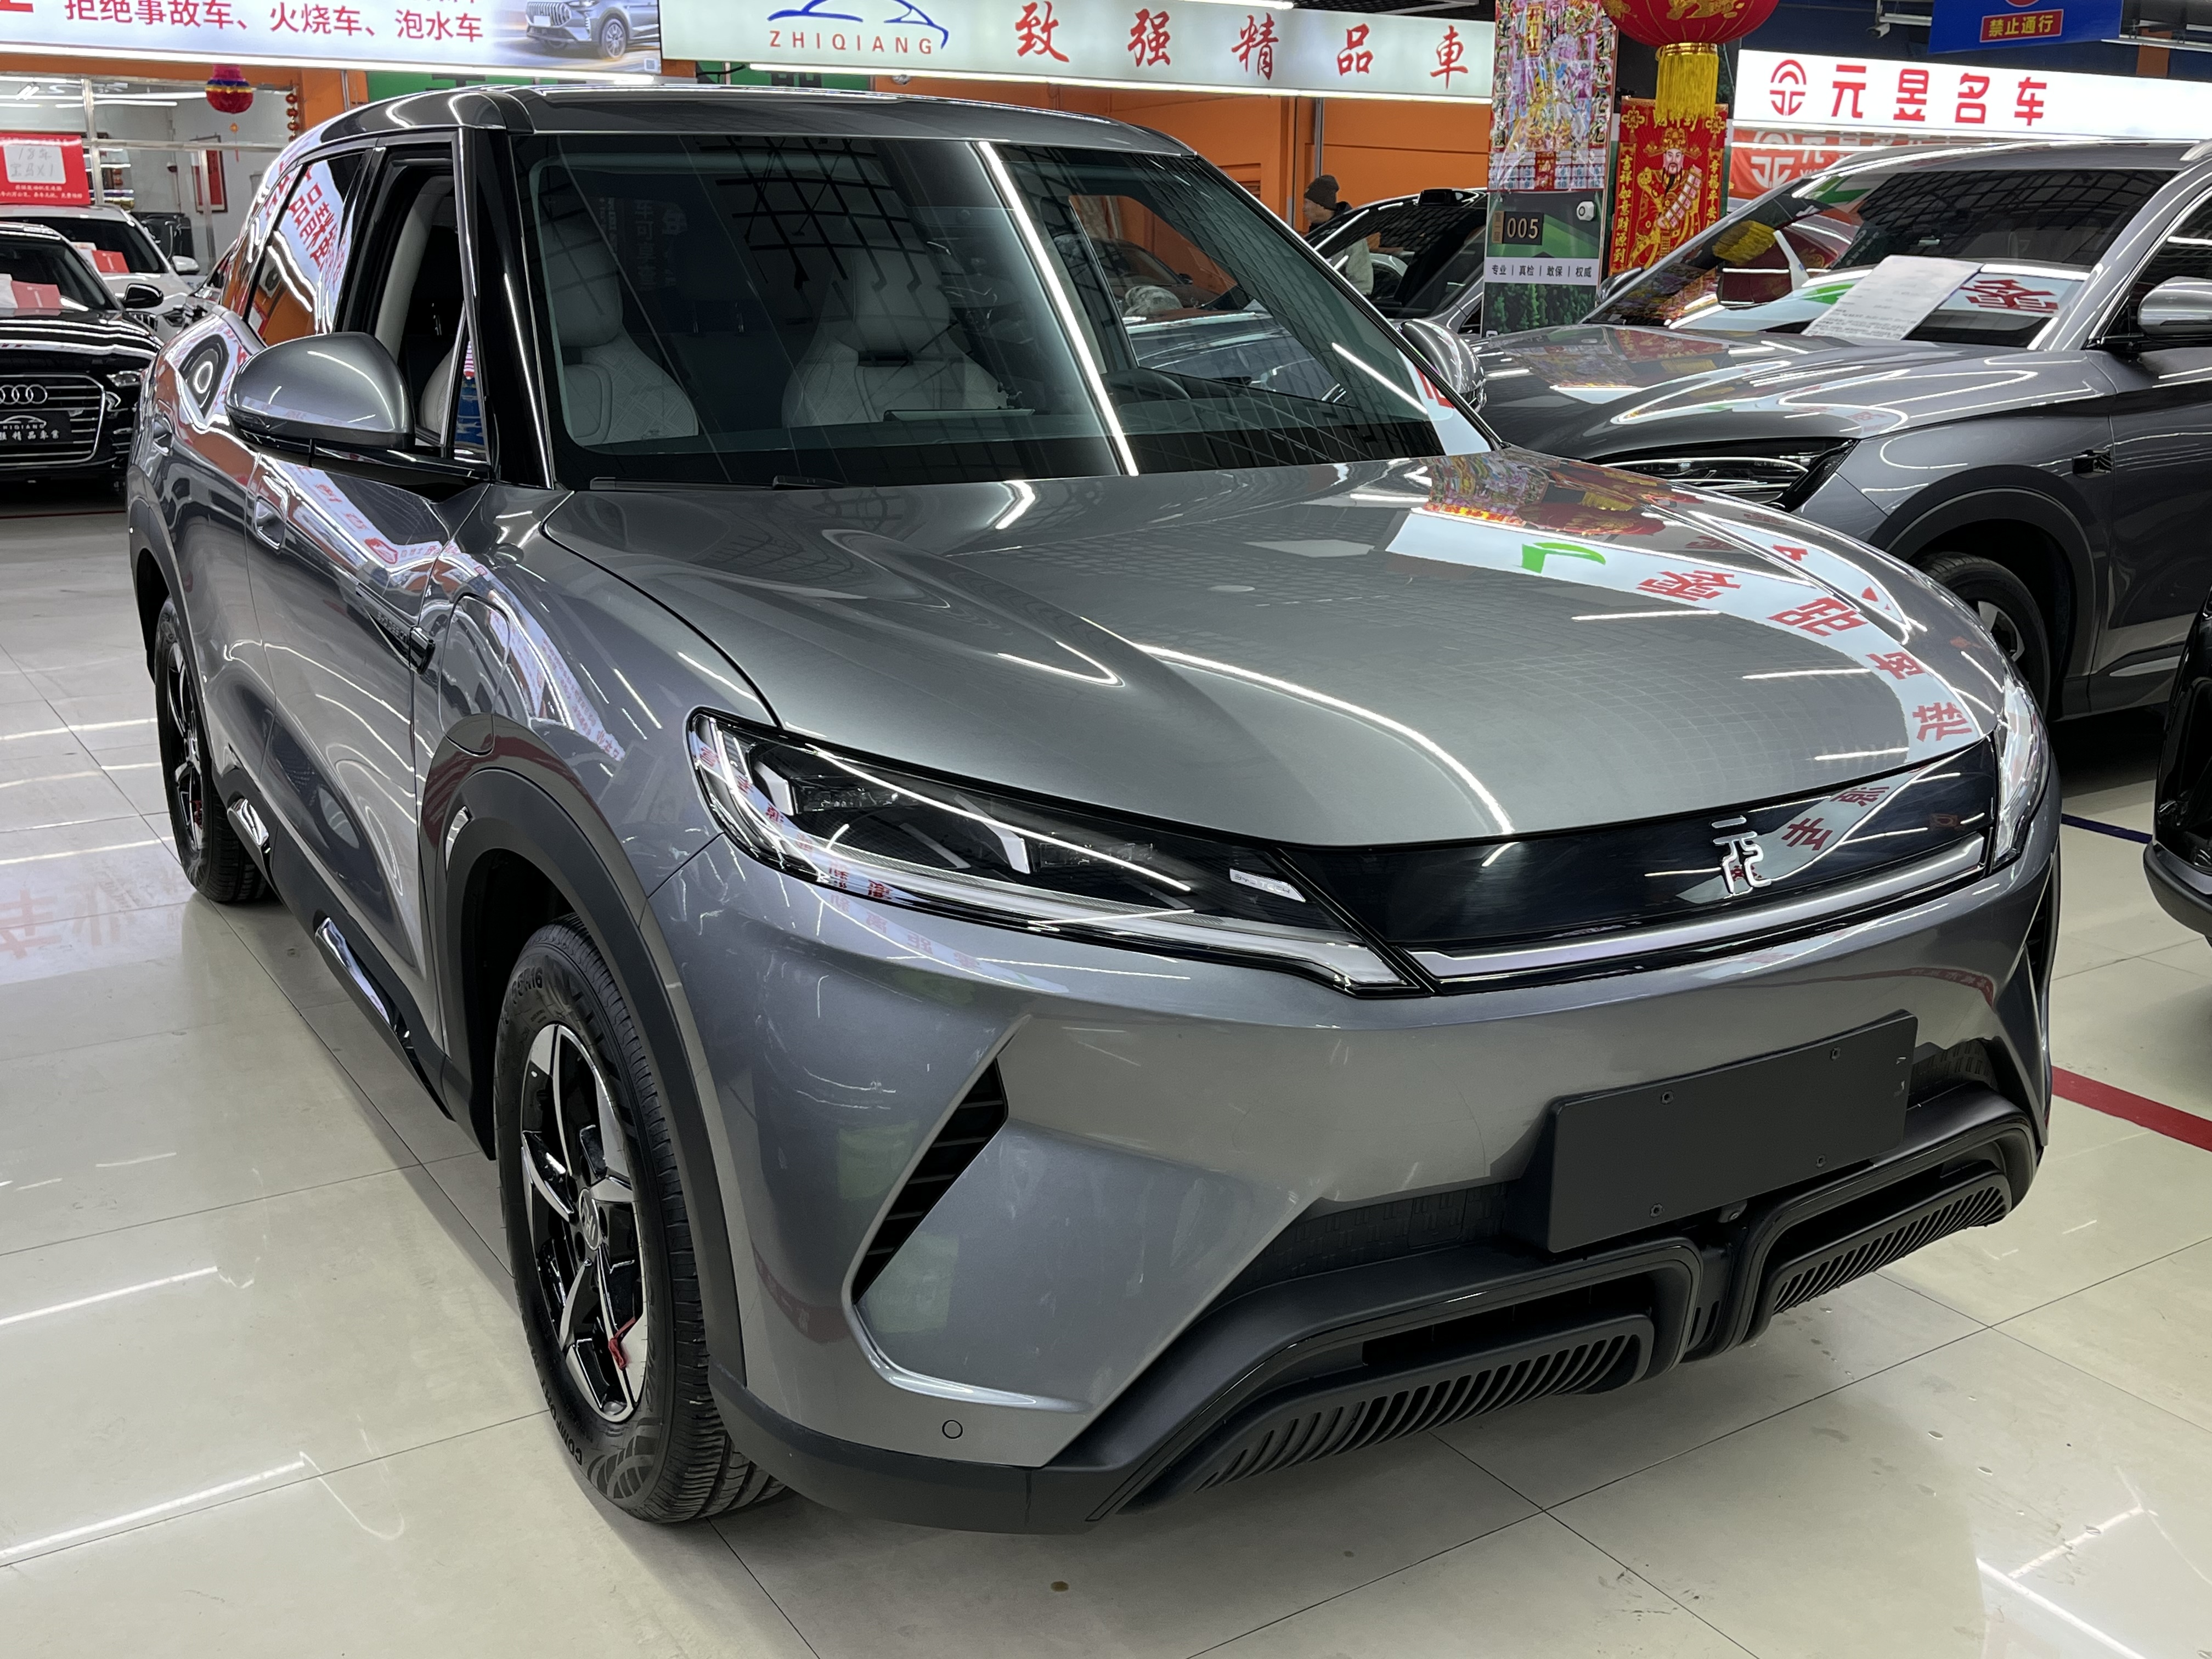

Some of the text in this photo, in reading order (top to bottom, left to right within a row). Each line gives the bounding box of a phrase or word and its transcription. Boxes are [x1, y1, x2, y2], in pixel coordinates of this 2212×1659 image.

[1988, 14, 2054, 37] 禁止通行
[769, 30, 932, 55] ZHIQIANG
[1831, 64, 2047, 127] 元昱名车
[1506, 217, 1539, 239] 005
[1491, 264, 1592, 278] 专业 真检 敢保 权威
